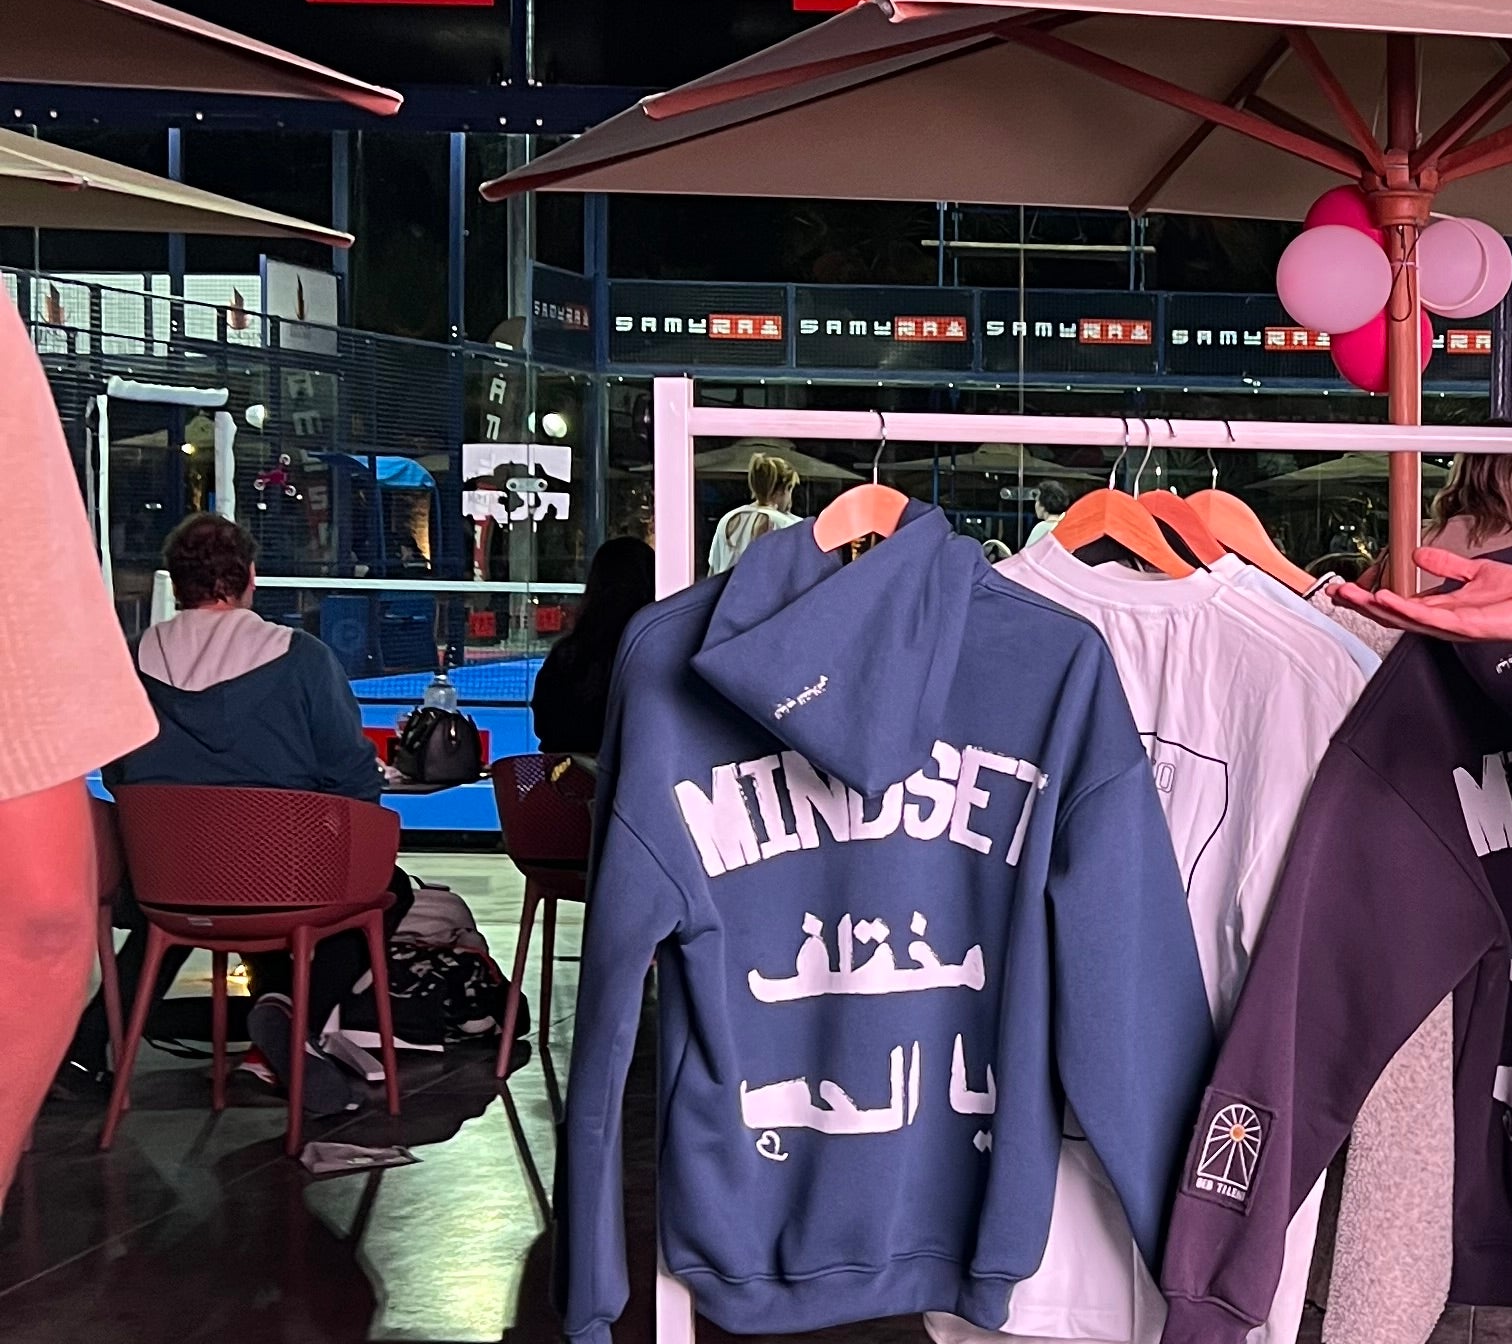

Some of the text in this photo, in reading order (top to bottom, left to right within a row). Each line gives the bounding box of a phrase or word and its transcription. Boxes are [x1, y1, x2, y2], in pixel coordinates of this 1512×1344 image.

[615, 316, 780, 337] SAMURAI
[800, 319, 964, 338] SAMURAI
[986, 320, 1150, 341] SAMURAI
[674, 739, 1049, 878] MINDSET
[748, 911, 986, 1002] مختلف
